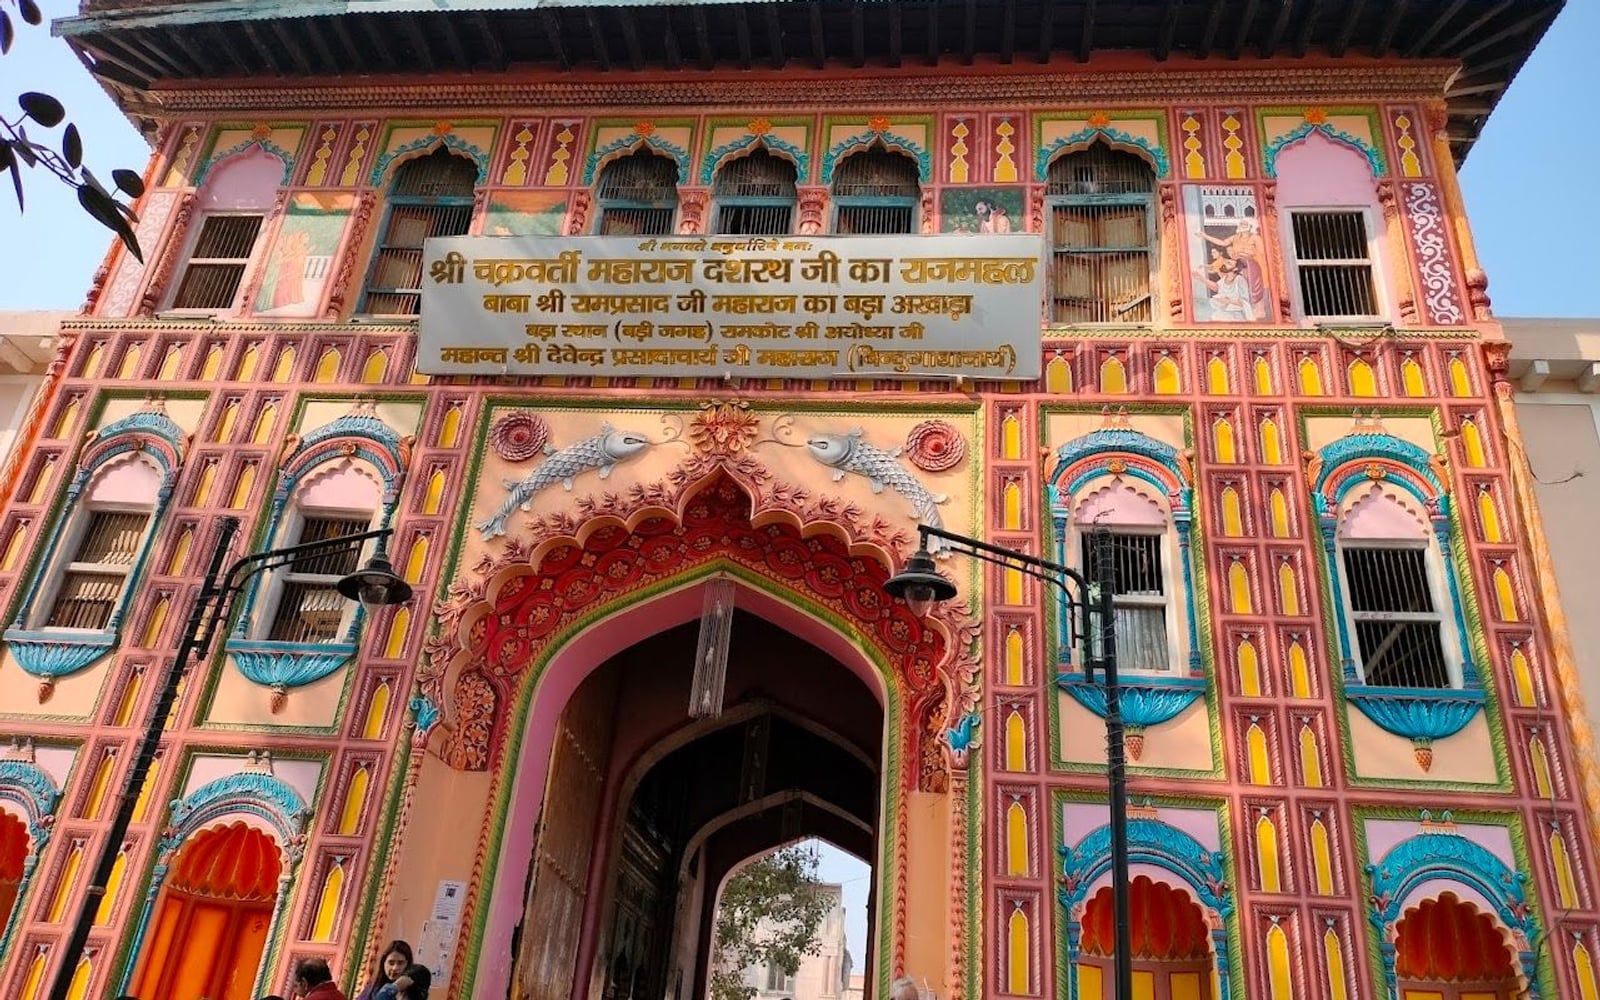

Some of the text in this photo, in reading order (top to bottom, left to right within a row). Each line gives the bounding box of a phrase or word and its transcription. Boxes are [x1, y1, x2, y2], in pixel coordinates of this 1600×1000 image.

[429, 250, 1037, 287] श्री चक्रवर्ती महाराज दशरथ जी का राजमहल
[483, 289, 973, 321] बाबा श्री रामप्रसाद जी महाराज का बड़ा अखाड़ा
[525, 324, 558, 341] बड़ा
[561, 324, 608, 338] स्थान
[794, 321, 820, 339] श्री
[824, 322, 895, 339] अयोध्या
[899, 321, 926, 339] जी
[441, 347, 509, 366] महान्त
[512, 343, 542, 365] श्री
[546, 343, 607, 366] देवेन्द्र
[722, 344, 752, 366] जी
